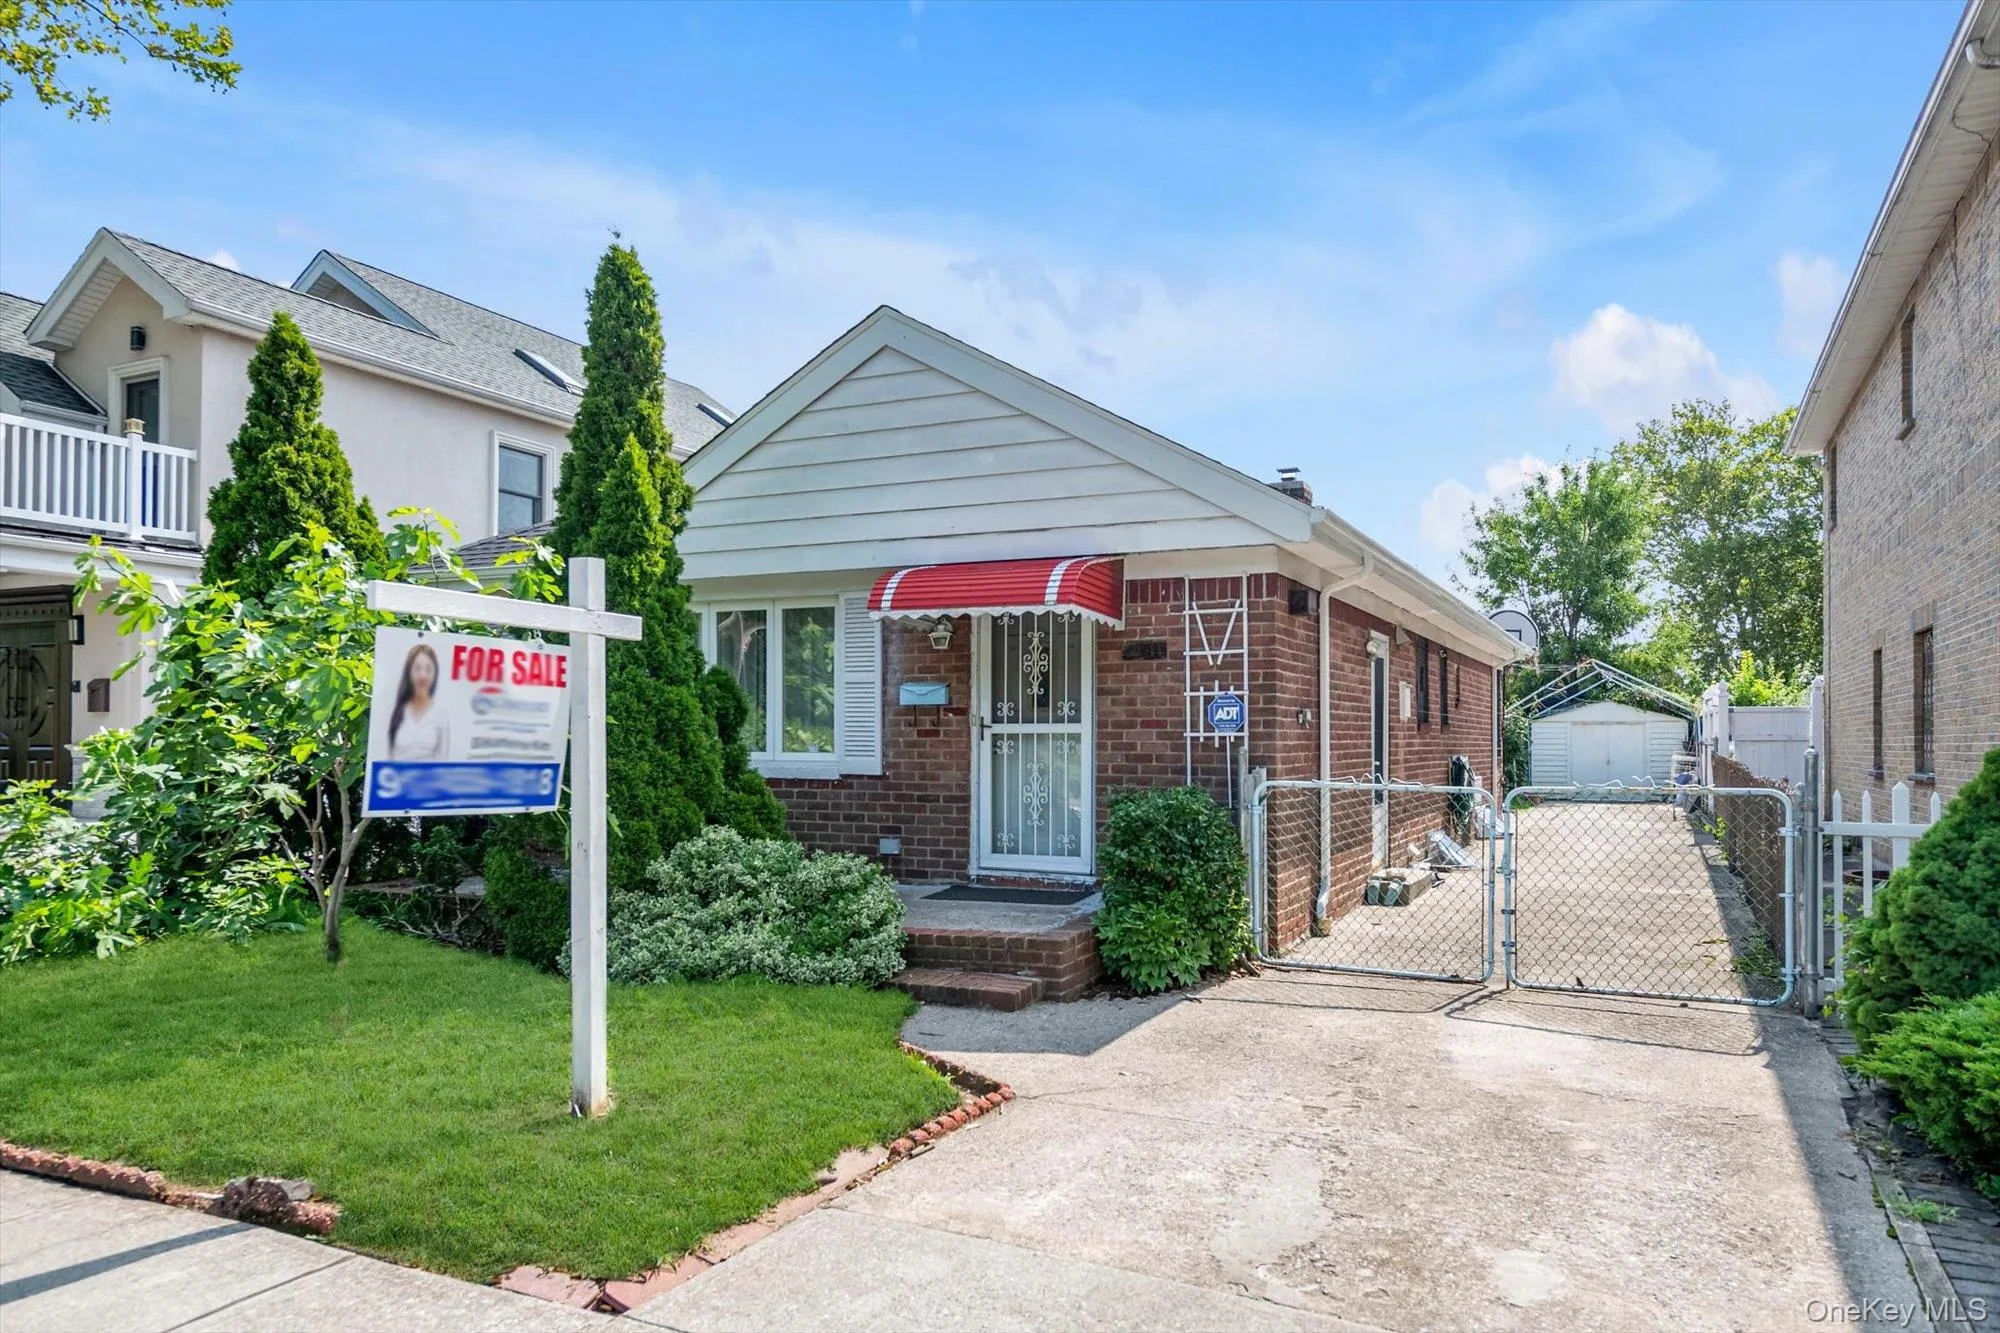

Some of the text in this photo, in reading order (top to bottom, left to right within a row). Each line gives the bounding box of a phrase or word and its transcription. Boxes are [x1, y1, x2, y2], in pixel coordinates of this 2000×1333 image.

[451, 645, 567, 688] FOR SALE
[1214, 706, 1239, 720] ADT
